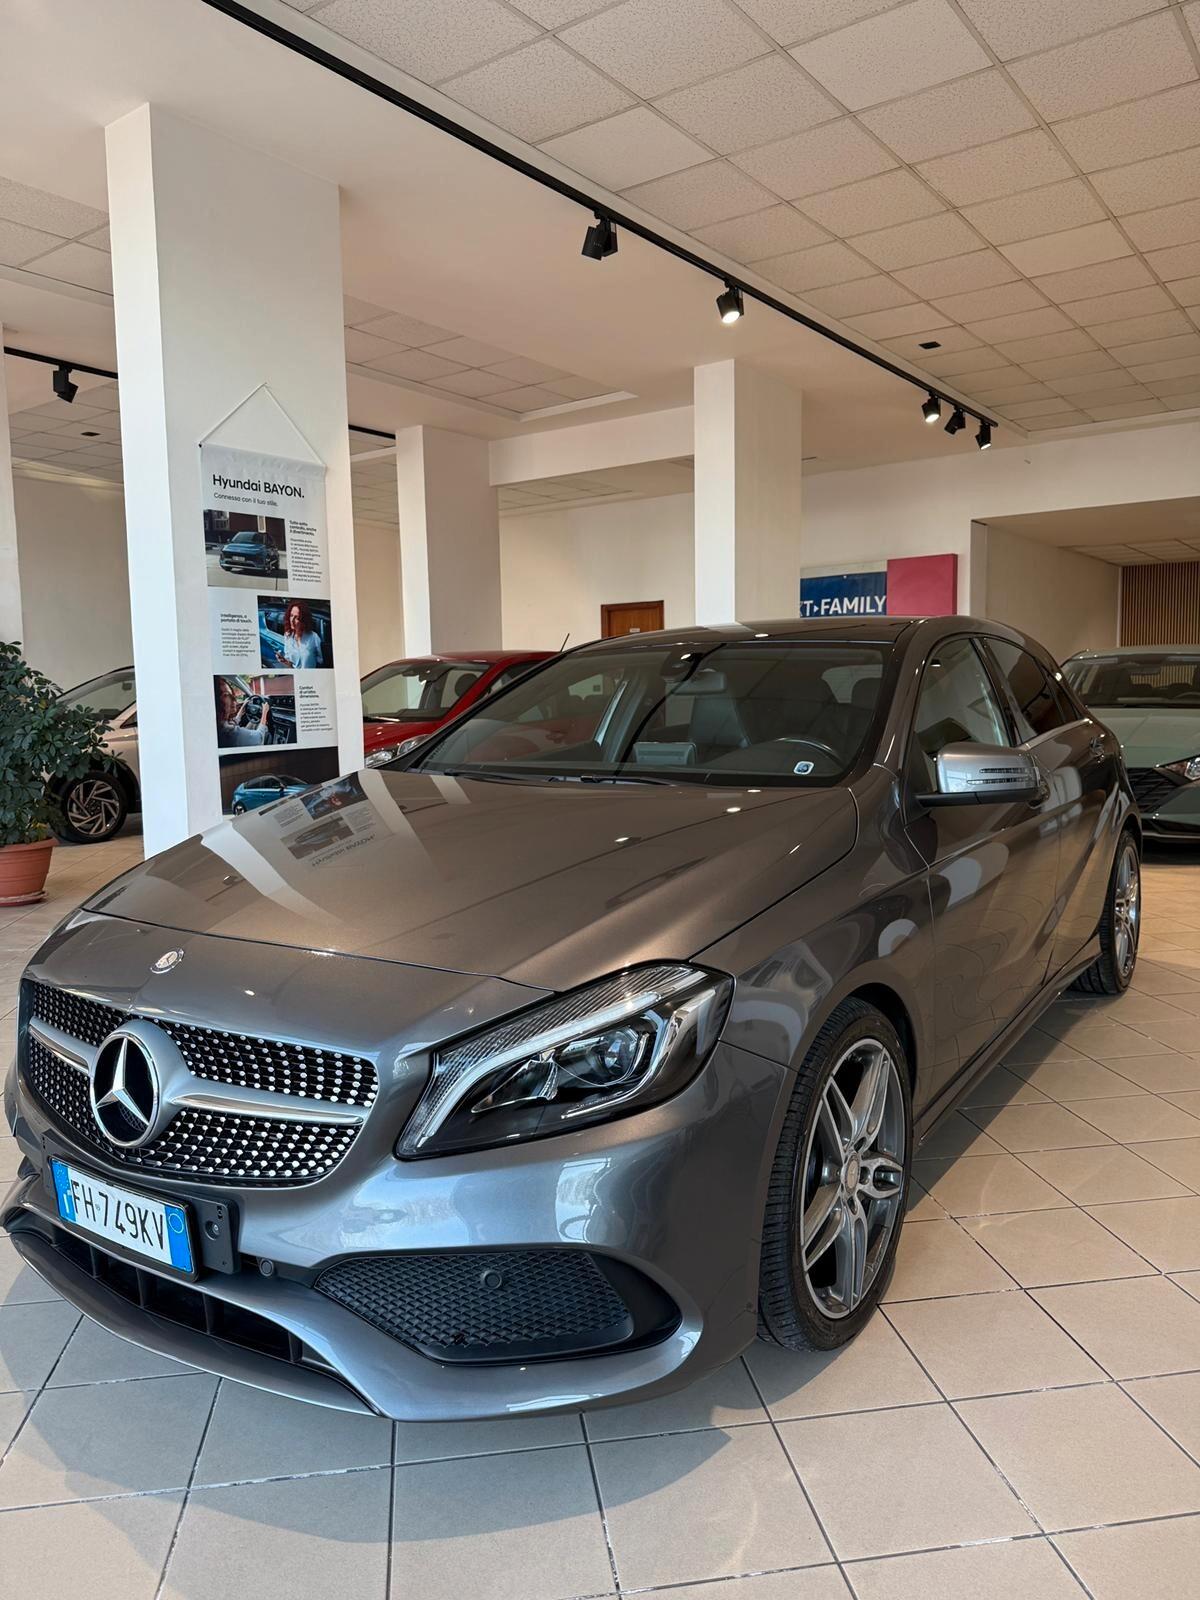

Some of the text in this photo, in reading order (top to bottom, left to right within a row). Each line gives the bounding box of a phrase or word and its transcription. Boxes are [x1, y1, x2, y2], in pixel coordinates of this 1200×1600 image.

[213, 474, 304, 498] Hyundai BAYON.
[821, 595, 886, 615] FAMILY
